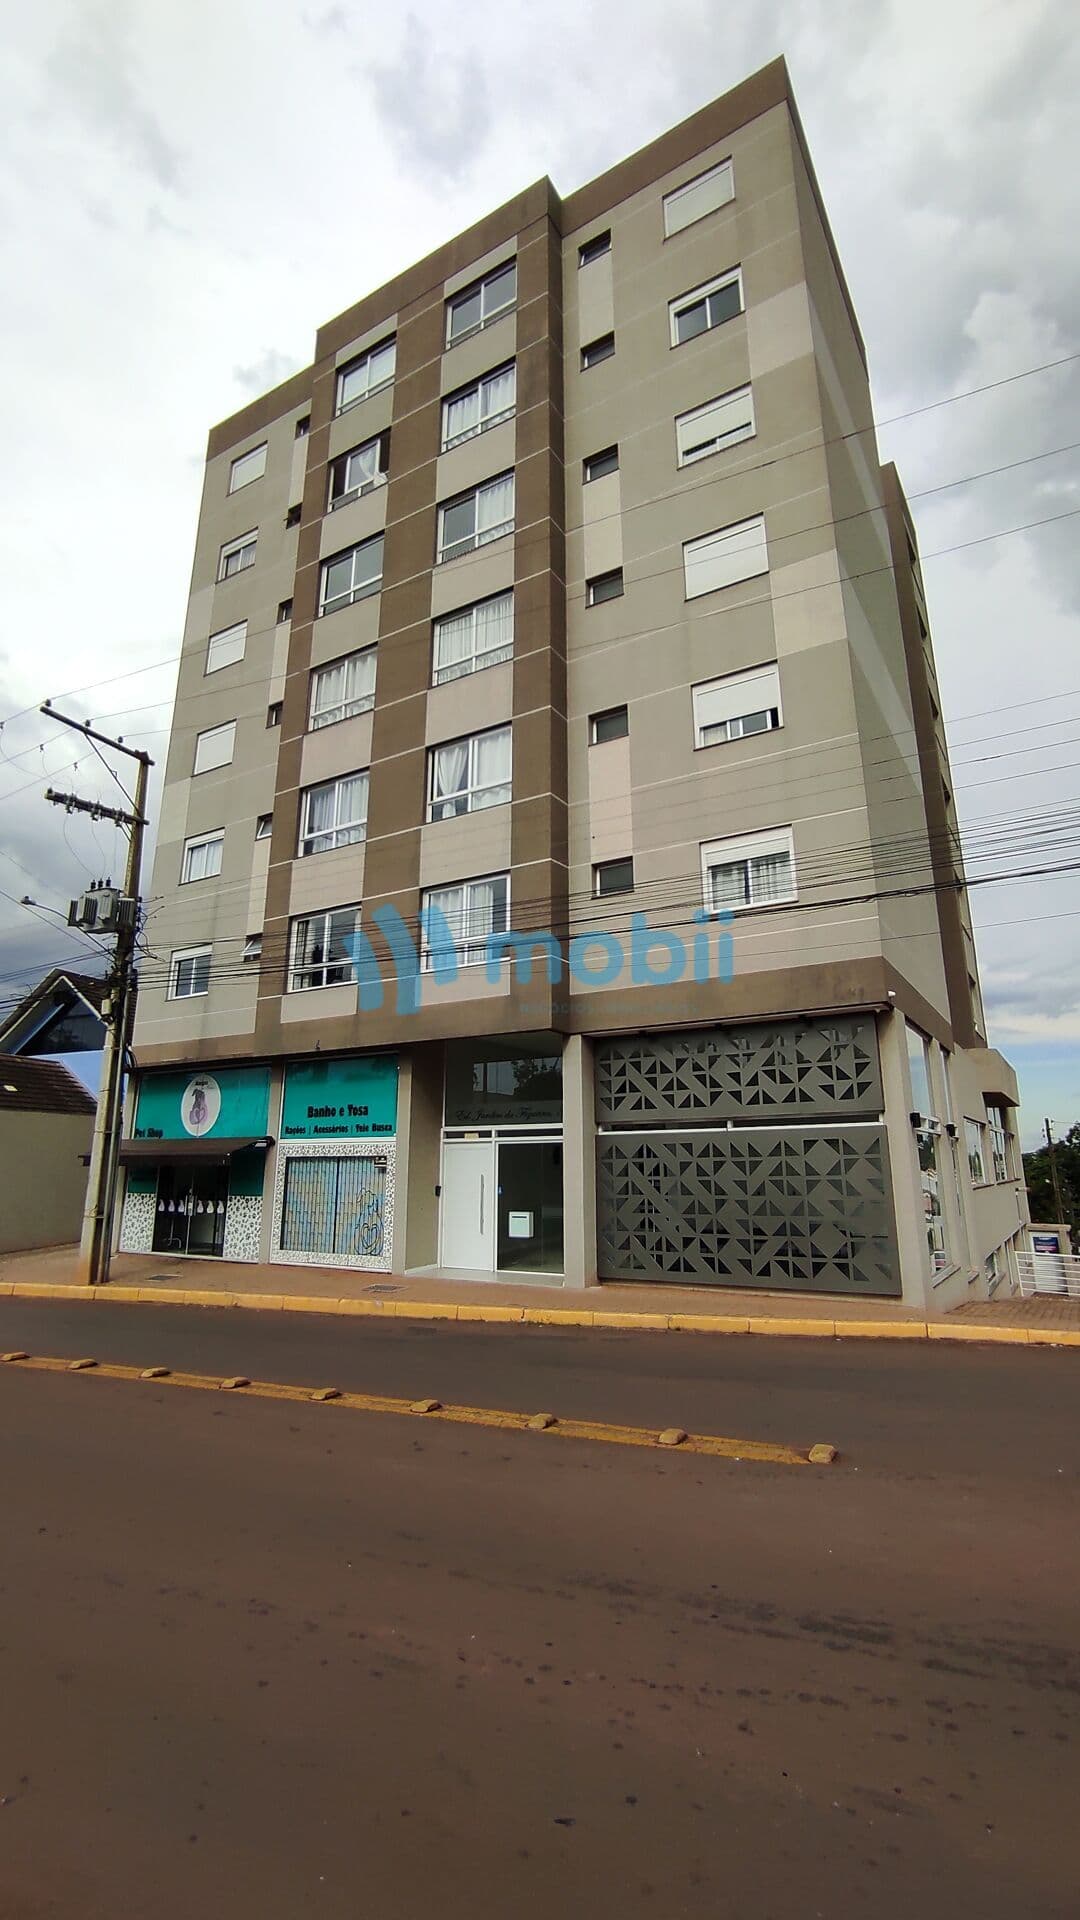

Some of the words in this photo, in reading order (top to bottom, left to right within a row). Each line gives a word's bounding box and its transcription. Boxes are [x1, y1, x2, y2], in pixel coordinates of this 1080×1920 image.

[307, 1105, 337, 1118] Banho
[339, 1107, 345, 1116] e
[347, 1104, 369, 1116] Tosa
[134, 1127, 145, 1138] Pet
[147, 1127, 164, 1139] Shop
[285, 1126, 306, 1135] Rações
[313, 1124, 348, 1134] Acessórios
[372, 1123, 392, 1132] Busca
